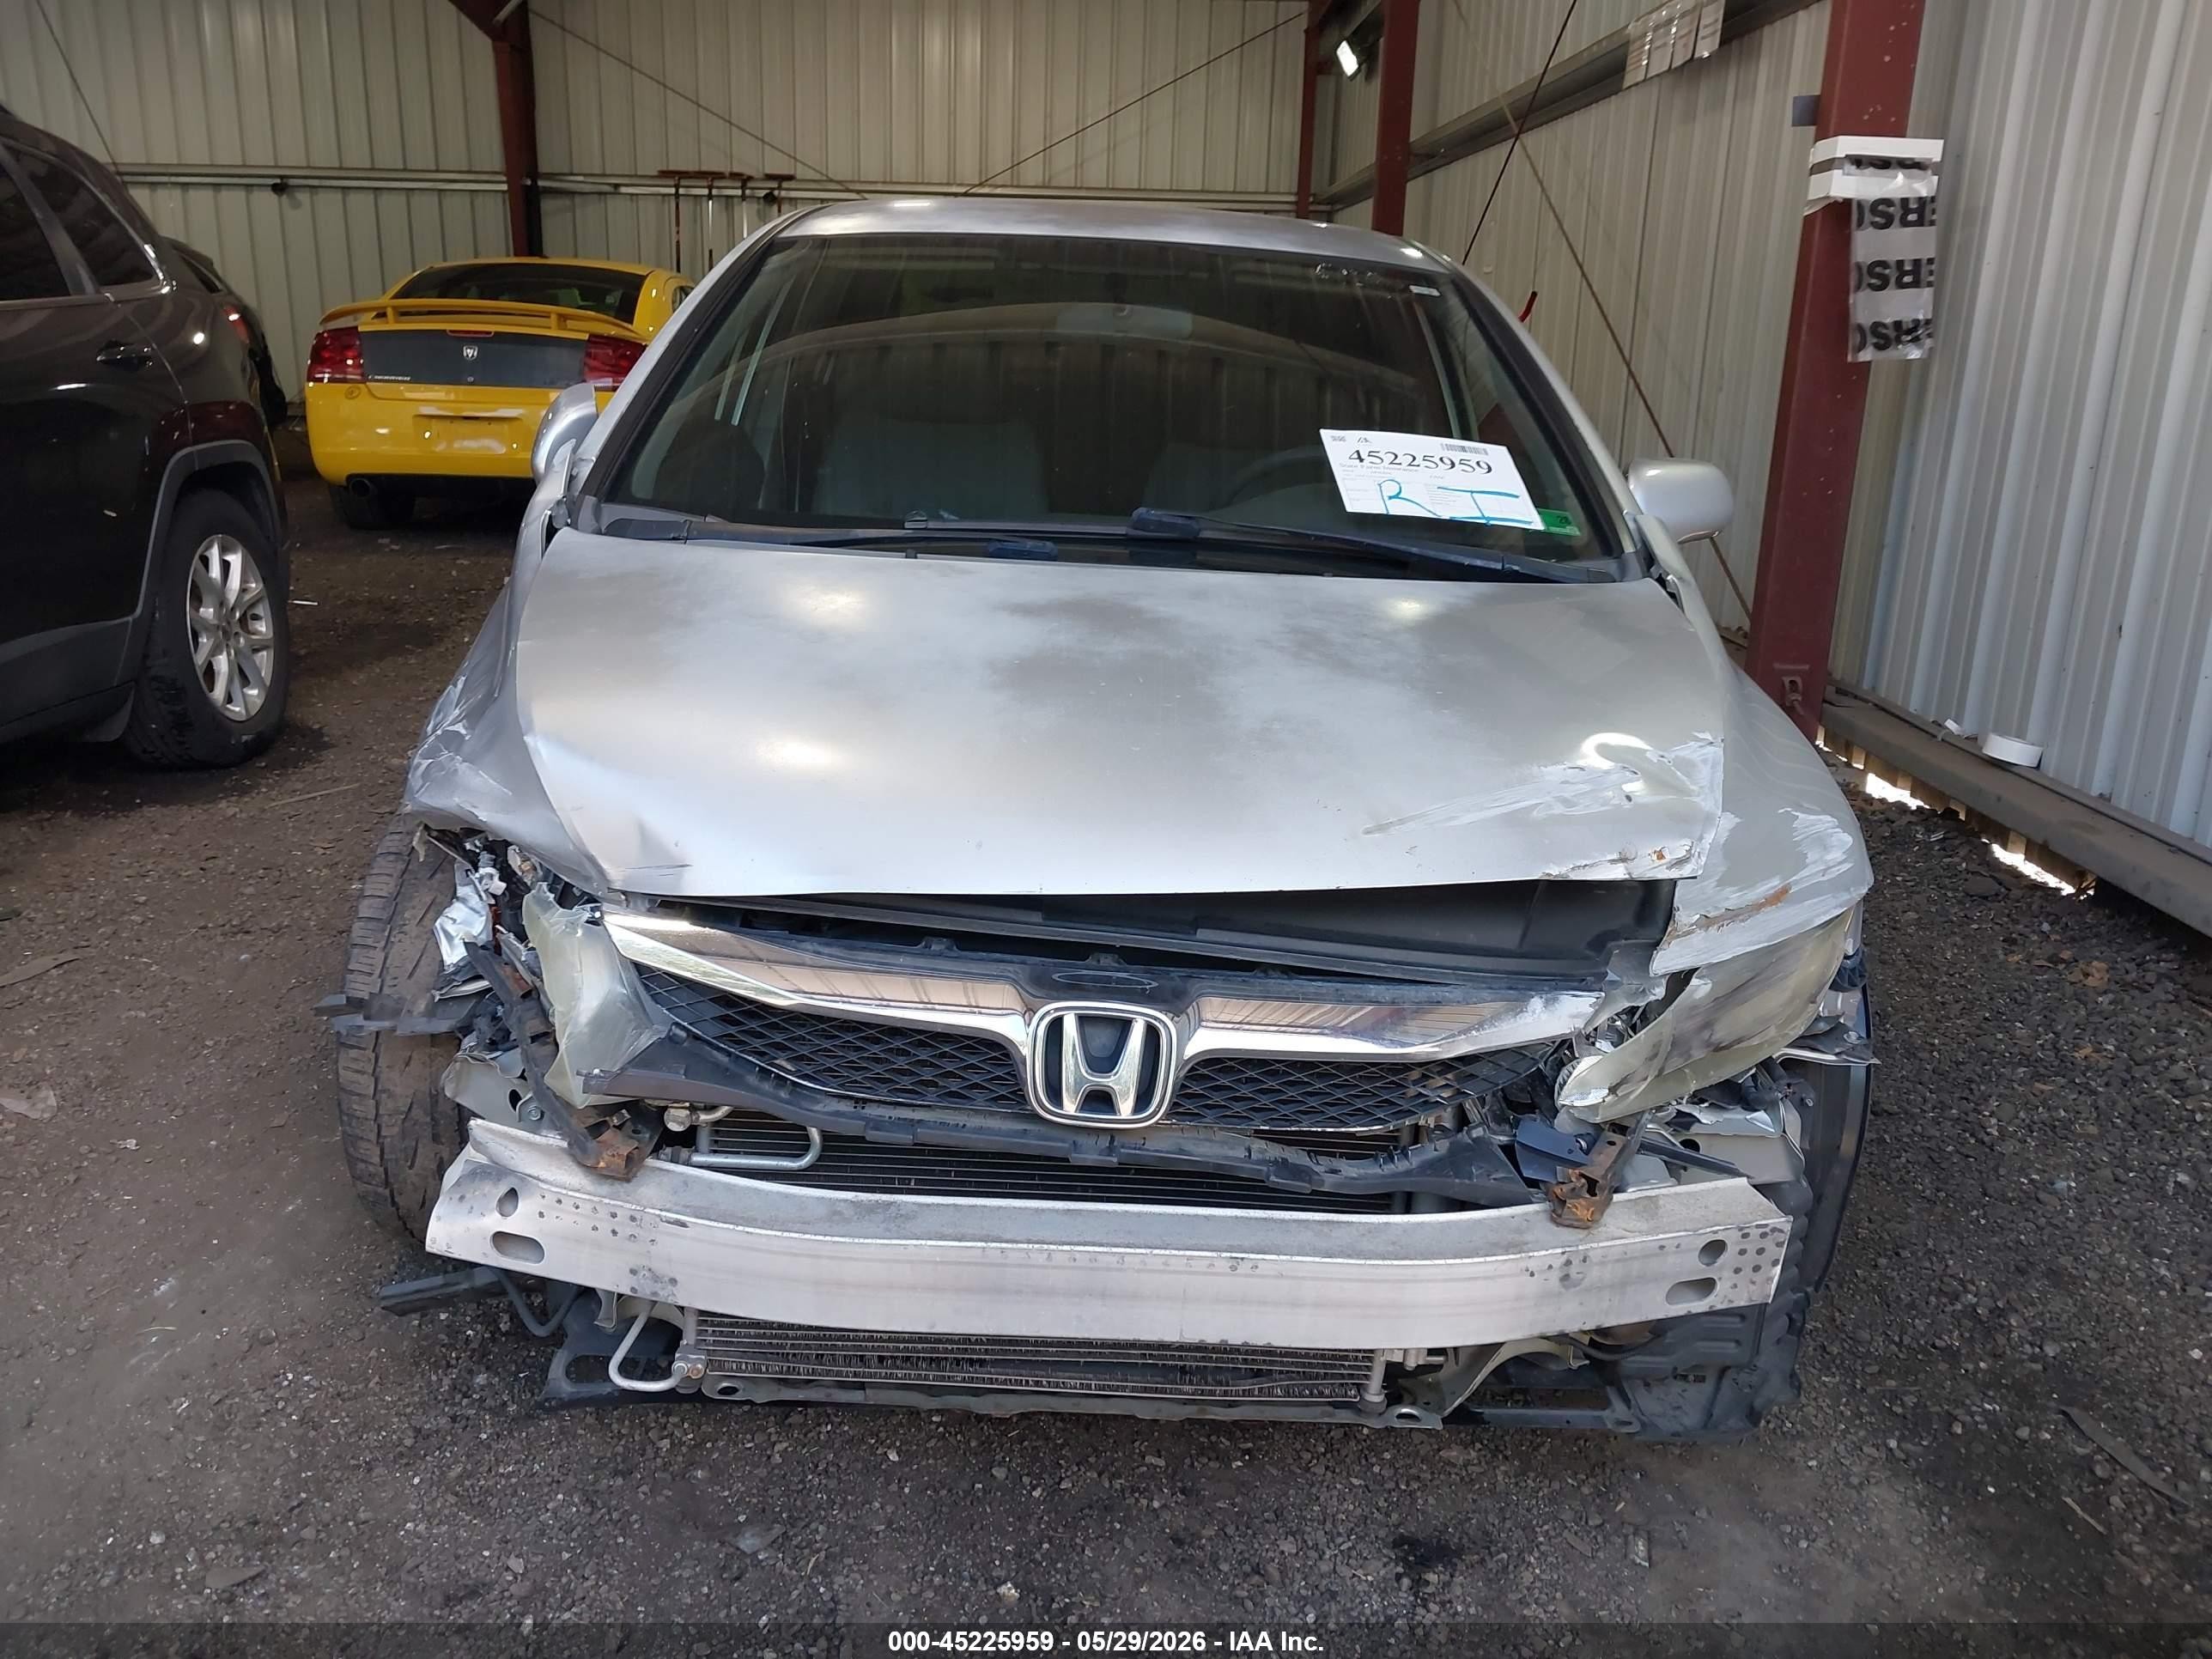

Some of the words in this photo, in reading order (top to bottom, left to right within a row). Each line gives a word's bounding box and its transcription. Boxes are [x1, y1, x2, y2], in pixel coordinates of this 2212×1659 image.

[1856, 197, 1936, 231] RS
[1854, 258, 1935, 292] RS
[1348, 449, 1492, 475] 45225959
